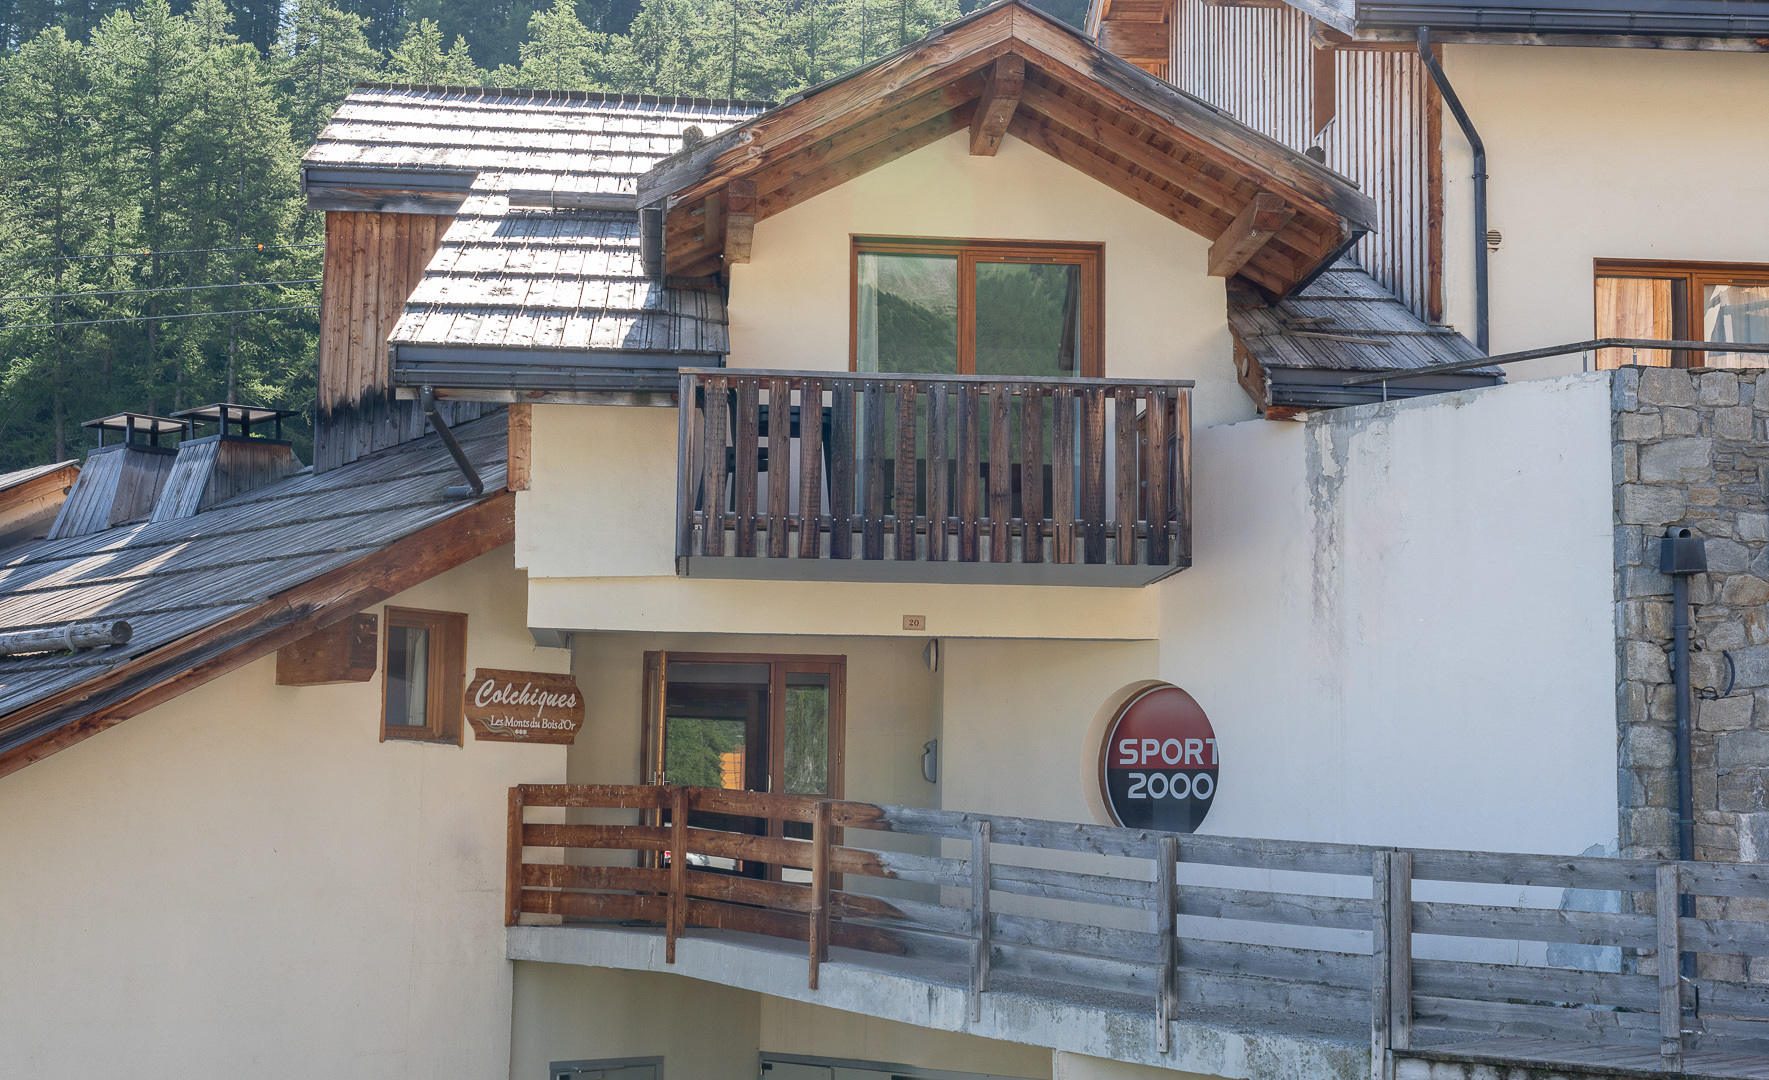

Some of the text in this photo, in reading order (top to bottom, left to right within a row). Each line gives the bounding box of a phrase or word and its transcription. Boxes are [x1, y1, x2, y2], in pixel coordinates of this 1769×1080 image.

[908, 618, 920, 626] 20
[475, 679, 577, 718] Colchiques
[490, 714, 576, 731] Les Monts du Bois d'Or
[1119, 738, 1218, 765] SPORT
[1127, 772, 1214, 800] 2000
